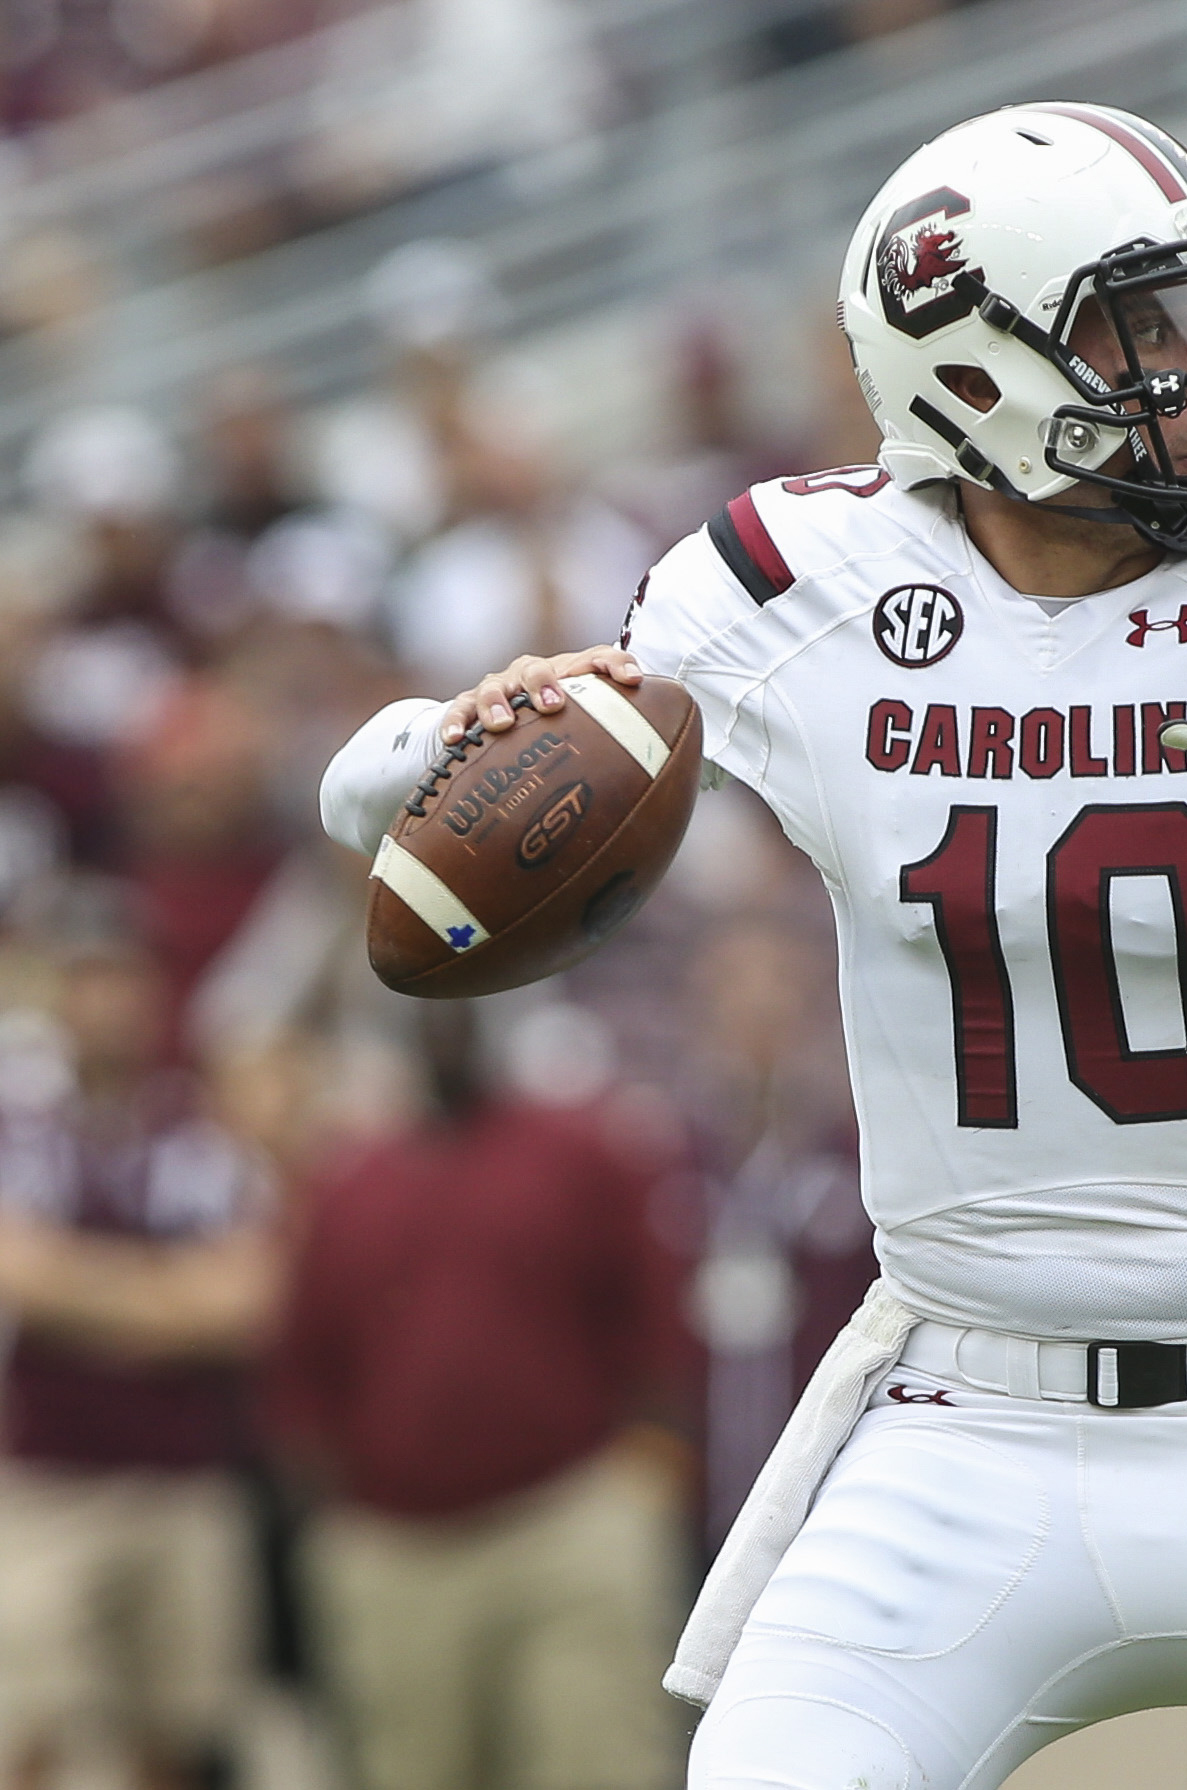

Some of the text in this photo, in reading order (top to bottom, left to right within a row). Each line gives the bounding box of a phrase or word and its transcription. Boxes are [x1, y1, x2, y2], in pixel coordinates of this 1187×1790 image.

[879, 586, 958, 662] SEC
[440, 731, 564, 838] Wilson
[521, 782, 584, 860] GST
